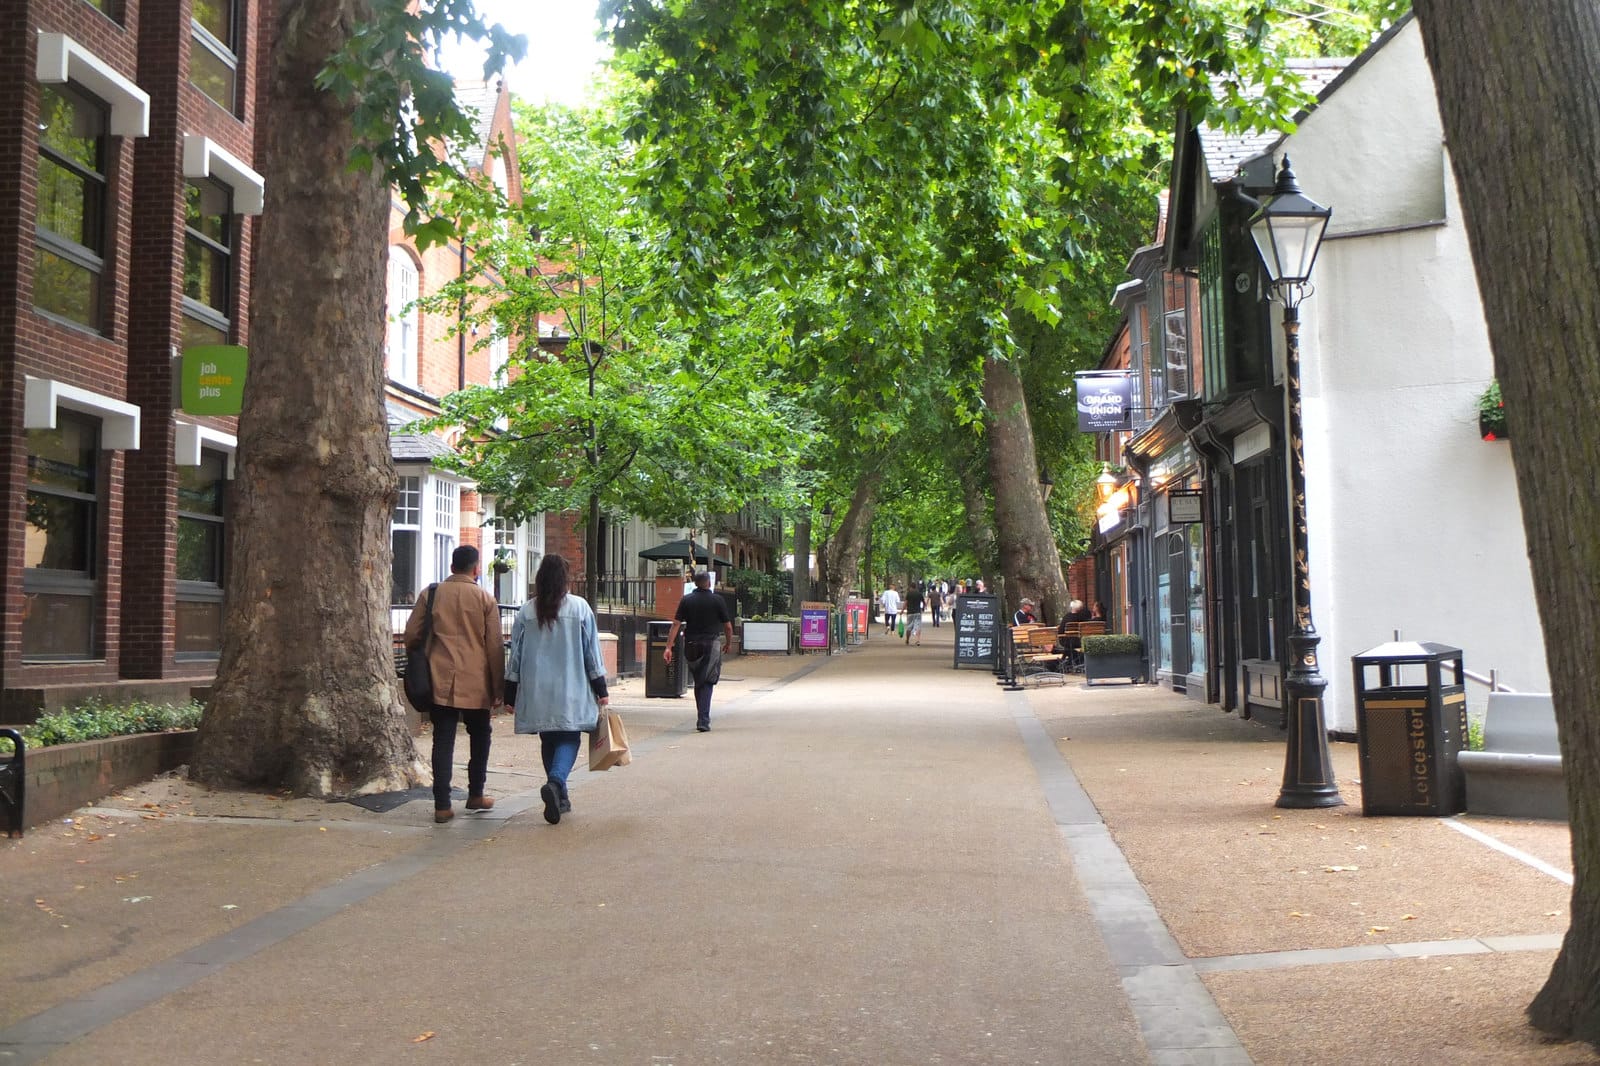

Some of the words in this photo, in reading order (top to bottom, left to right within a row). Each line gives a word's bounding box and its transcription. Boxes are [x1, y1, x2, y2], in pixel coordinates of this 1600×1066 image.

[201, 362, 217, 376] job
[199, 375, 232, 385] centre
[200, 386, 221, 399] plus
[1086, 395, 1122, 403] GRAND
[1089, 406, 1122, 415] UNION
[1410, 708, 1429, 806] Leicester
